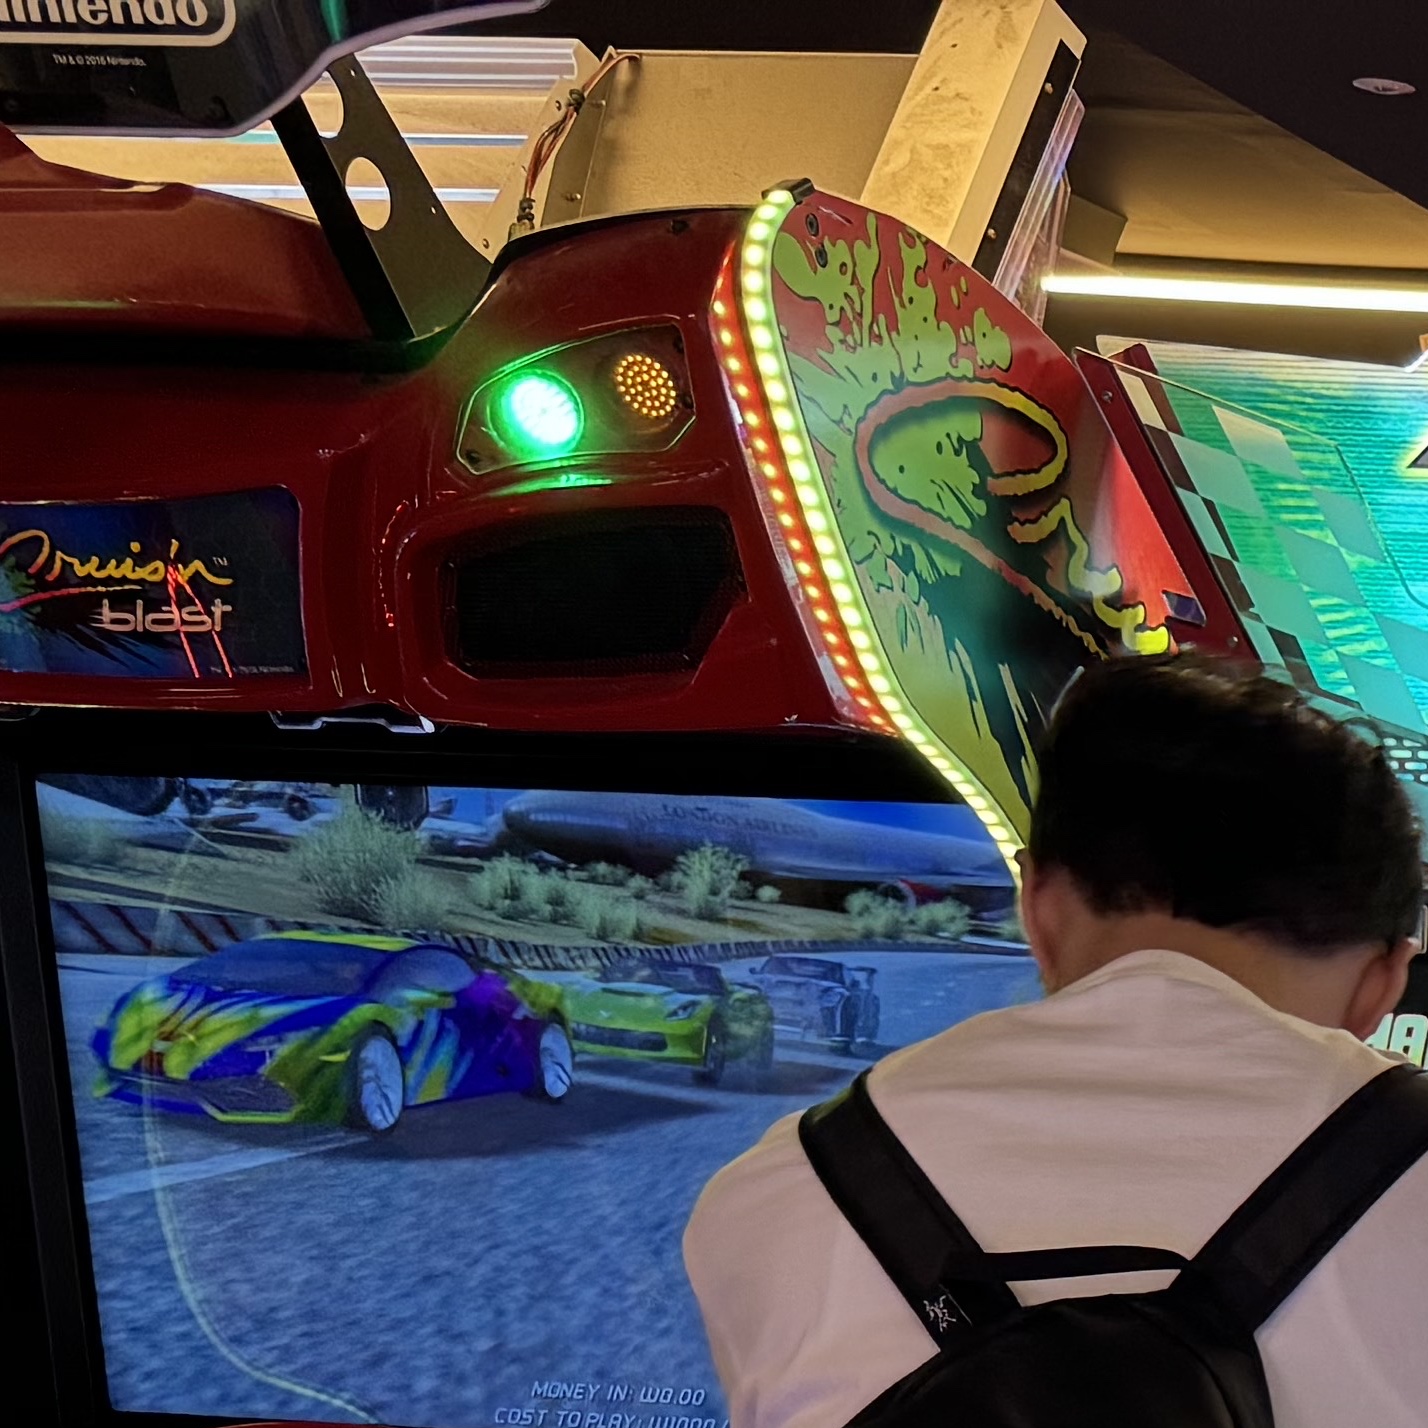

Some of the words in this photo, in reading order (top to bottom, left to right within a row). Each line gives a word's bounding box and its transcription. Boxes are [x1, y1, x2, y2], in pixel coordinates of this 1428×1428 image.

[0, 0, 208, 27] intendo
[100, 598, 233, 632] blast
[531, 1380, 600, 1400] MONEY
[606, 1384, 633, 1401] IN:
[495, 1407, 549, 1426] COST
[558, 1410, 583, 1428] TO
